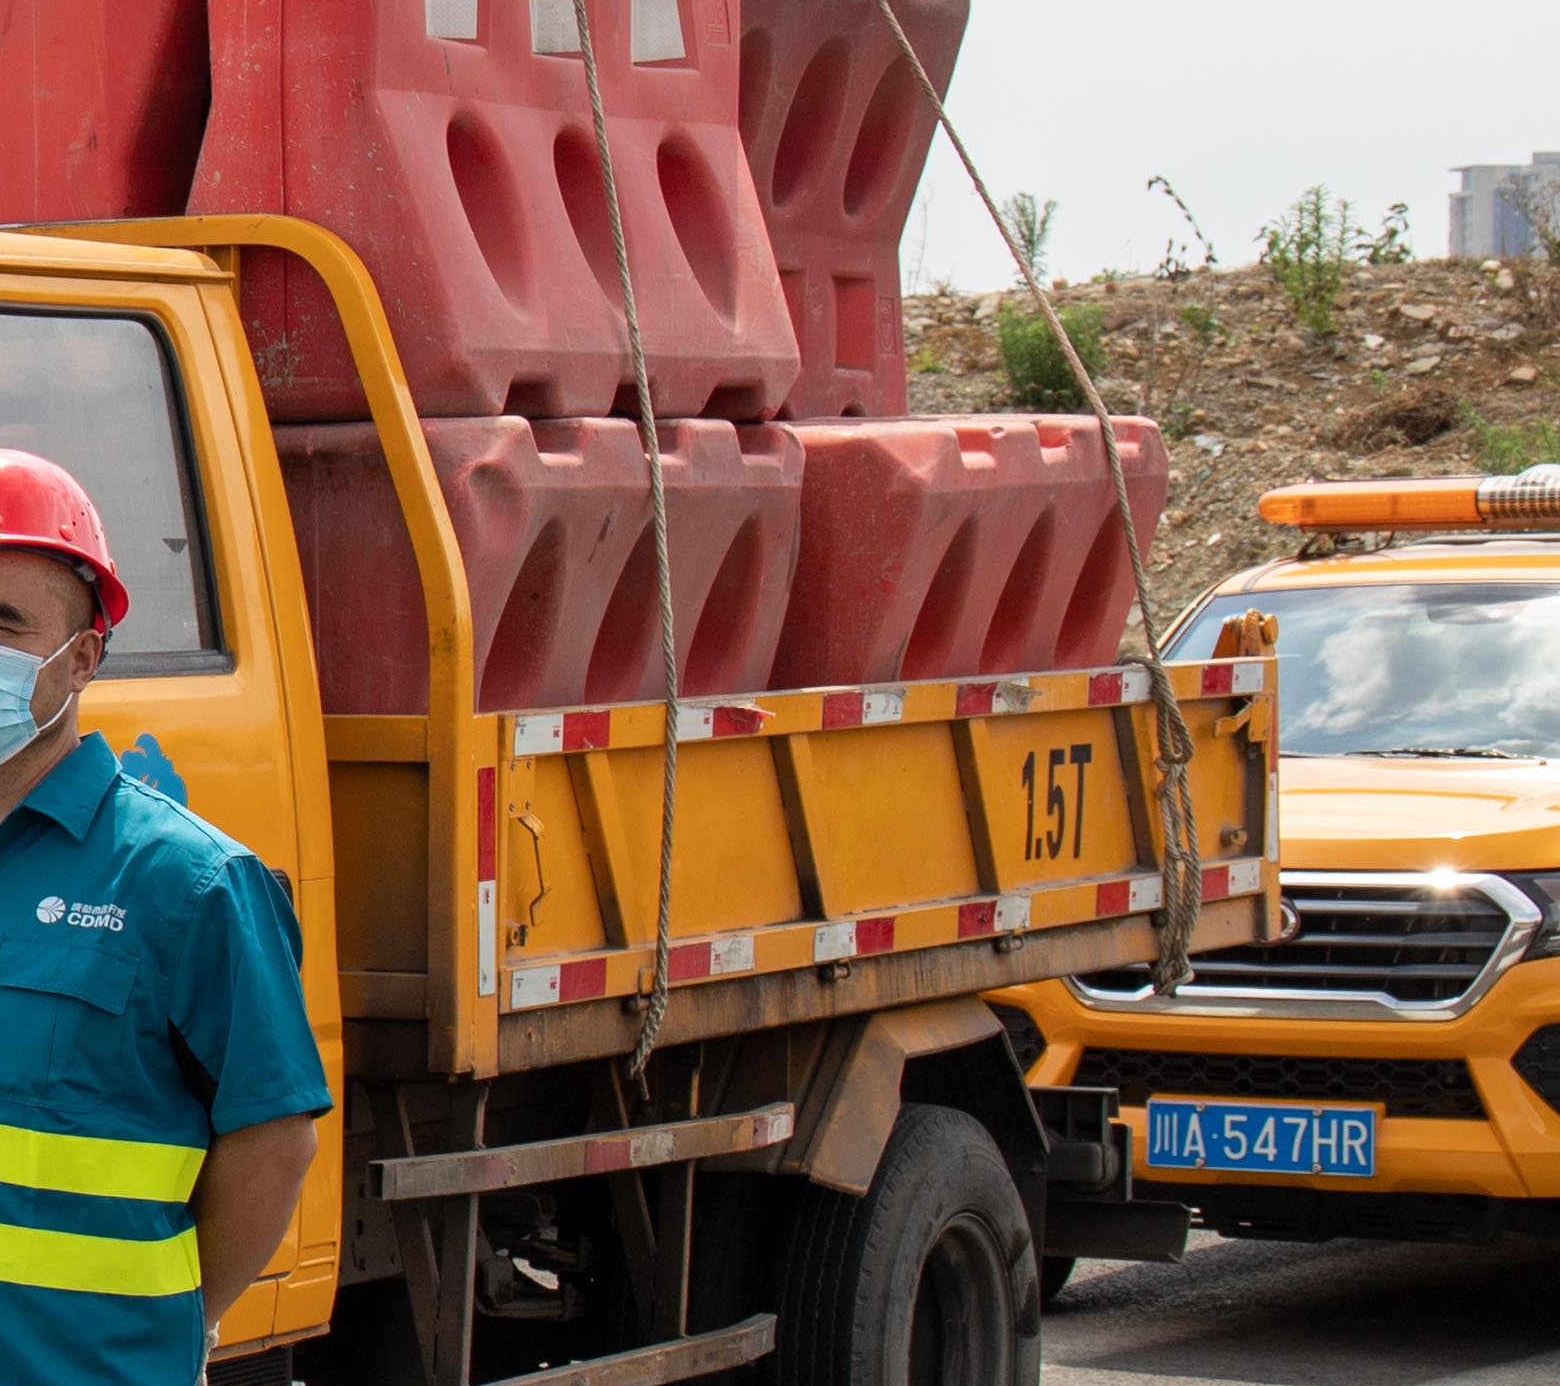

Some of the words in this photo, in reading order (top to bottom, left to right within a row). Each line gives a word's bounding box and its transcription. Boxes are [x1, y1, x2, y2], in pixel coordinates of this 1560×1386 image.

[1022, 743, 1092, 861] 1.5T
[66, 912, 124, 932] CDMD
[1154, 1113, 1368, 1165] 川A·547HR
